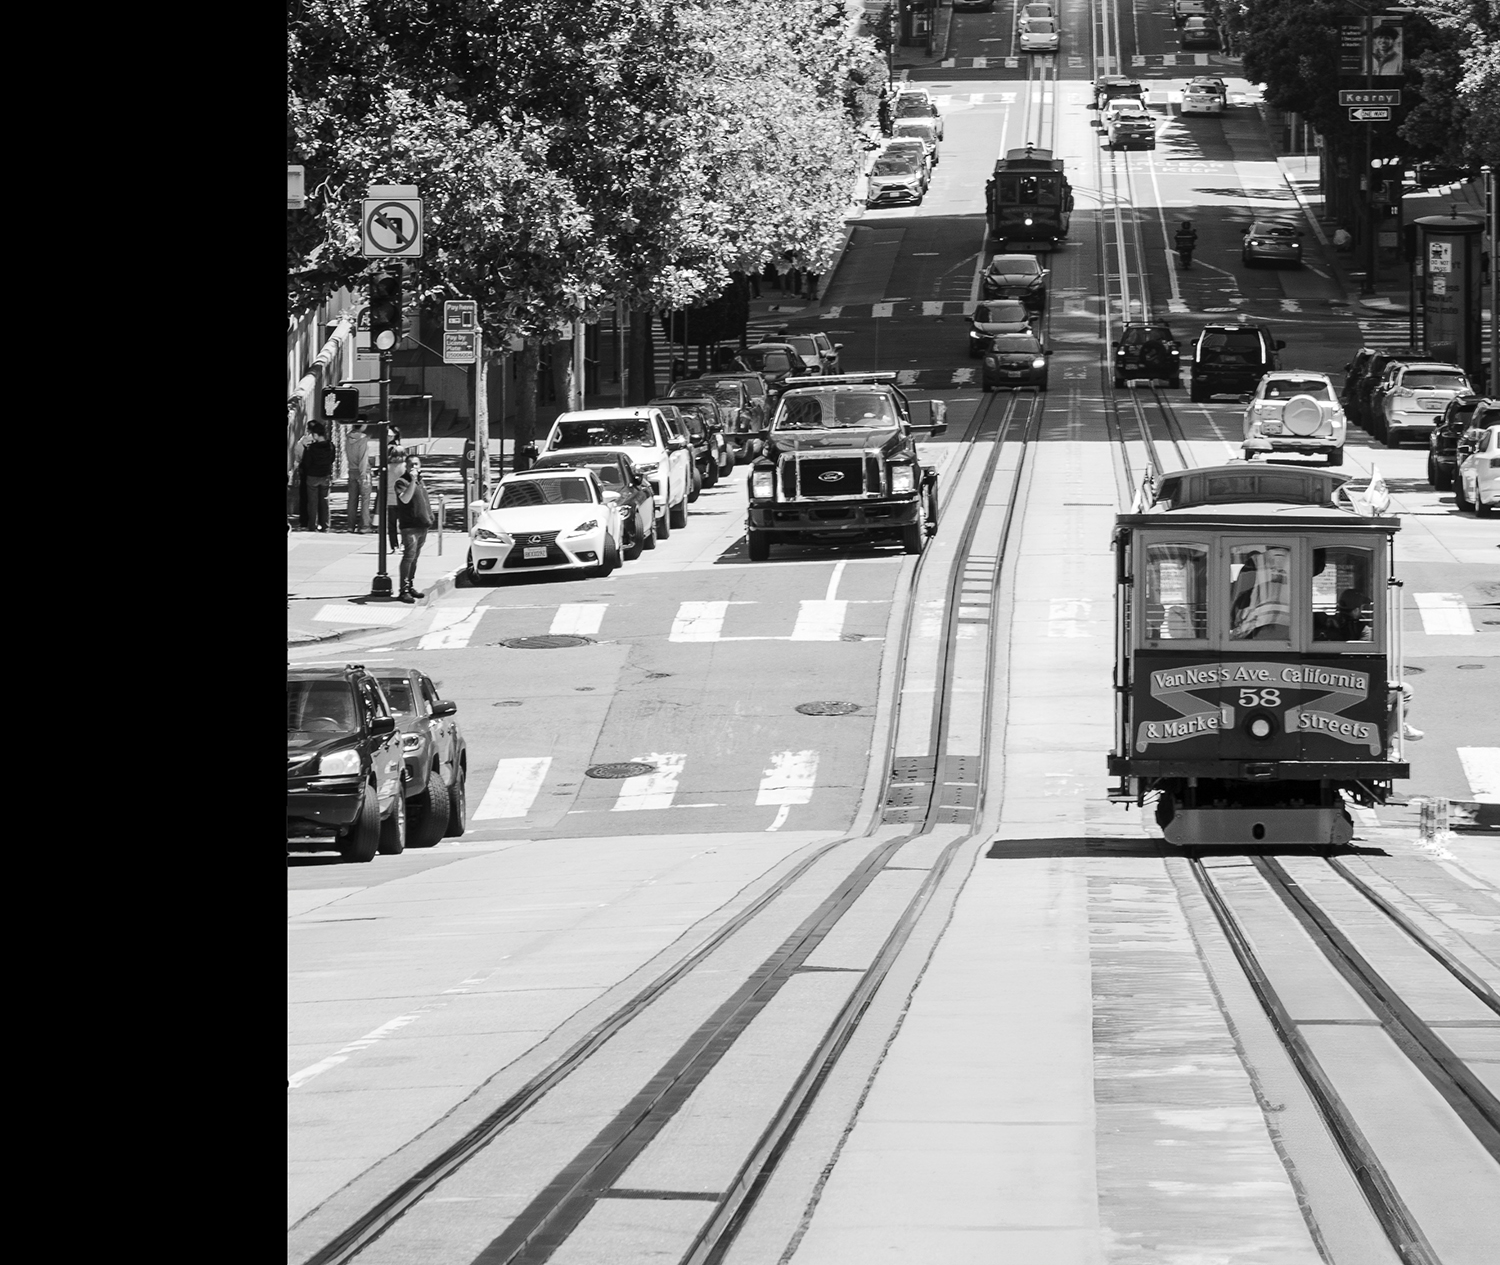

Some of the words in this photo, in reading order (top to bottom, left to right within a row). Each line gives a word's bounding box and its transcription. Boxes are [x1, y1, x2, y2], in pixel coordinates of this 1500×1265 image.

[1346, 94, 1393, 103] Kearny
[1154, 673, 1186, 688] Van
[1281, 667, 1368, 689] California
[1238, 688, 1282, 707] 58
[1146, 723, 1160, 738] &
[1162, 707, 1228, 737] Market
[1298, 712, 1370, 738] Streets
